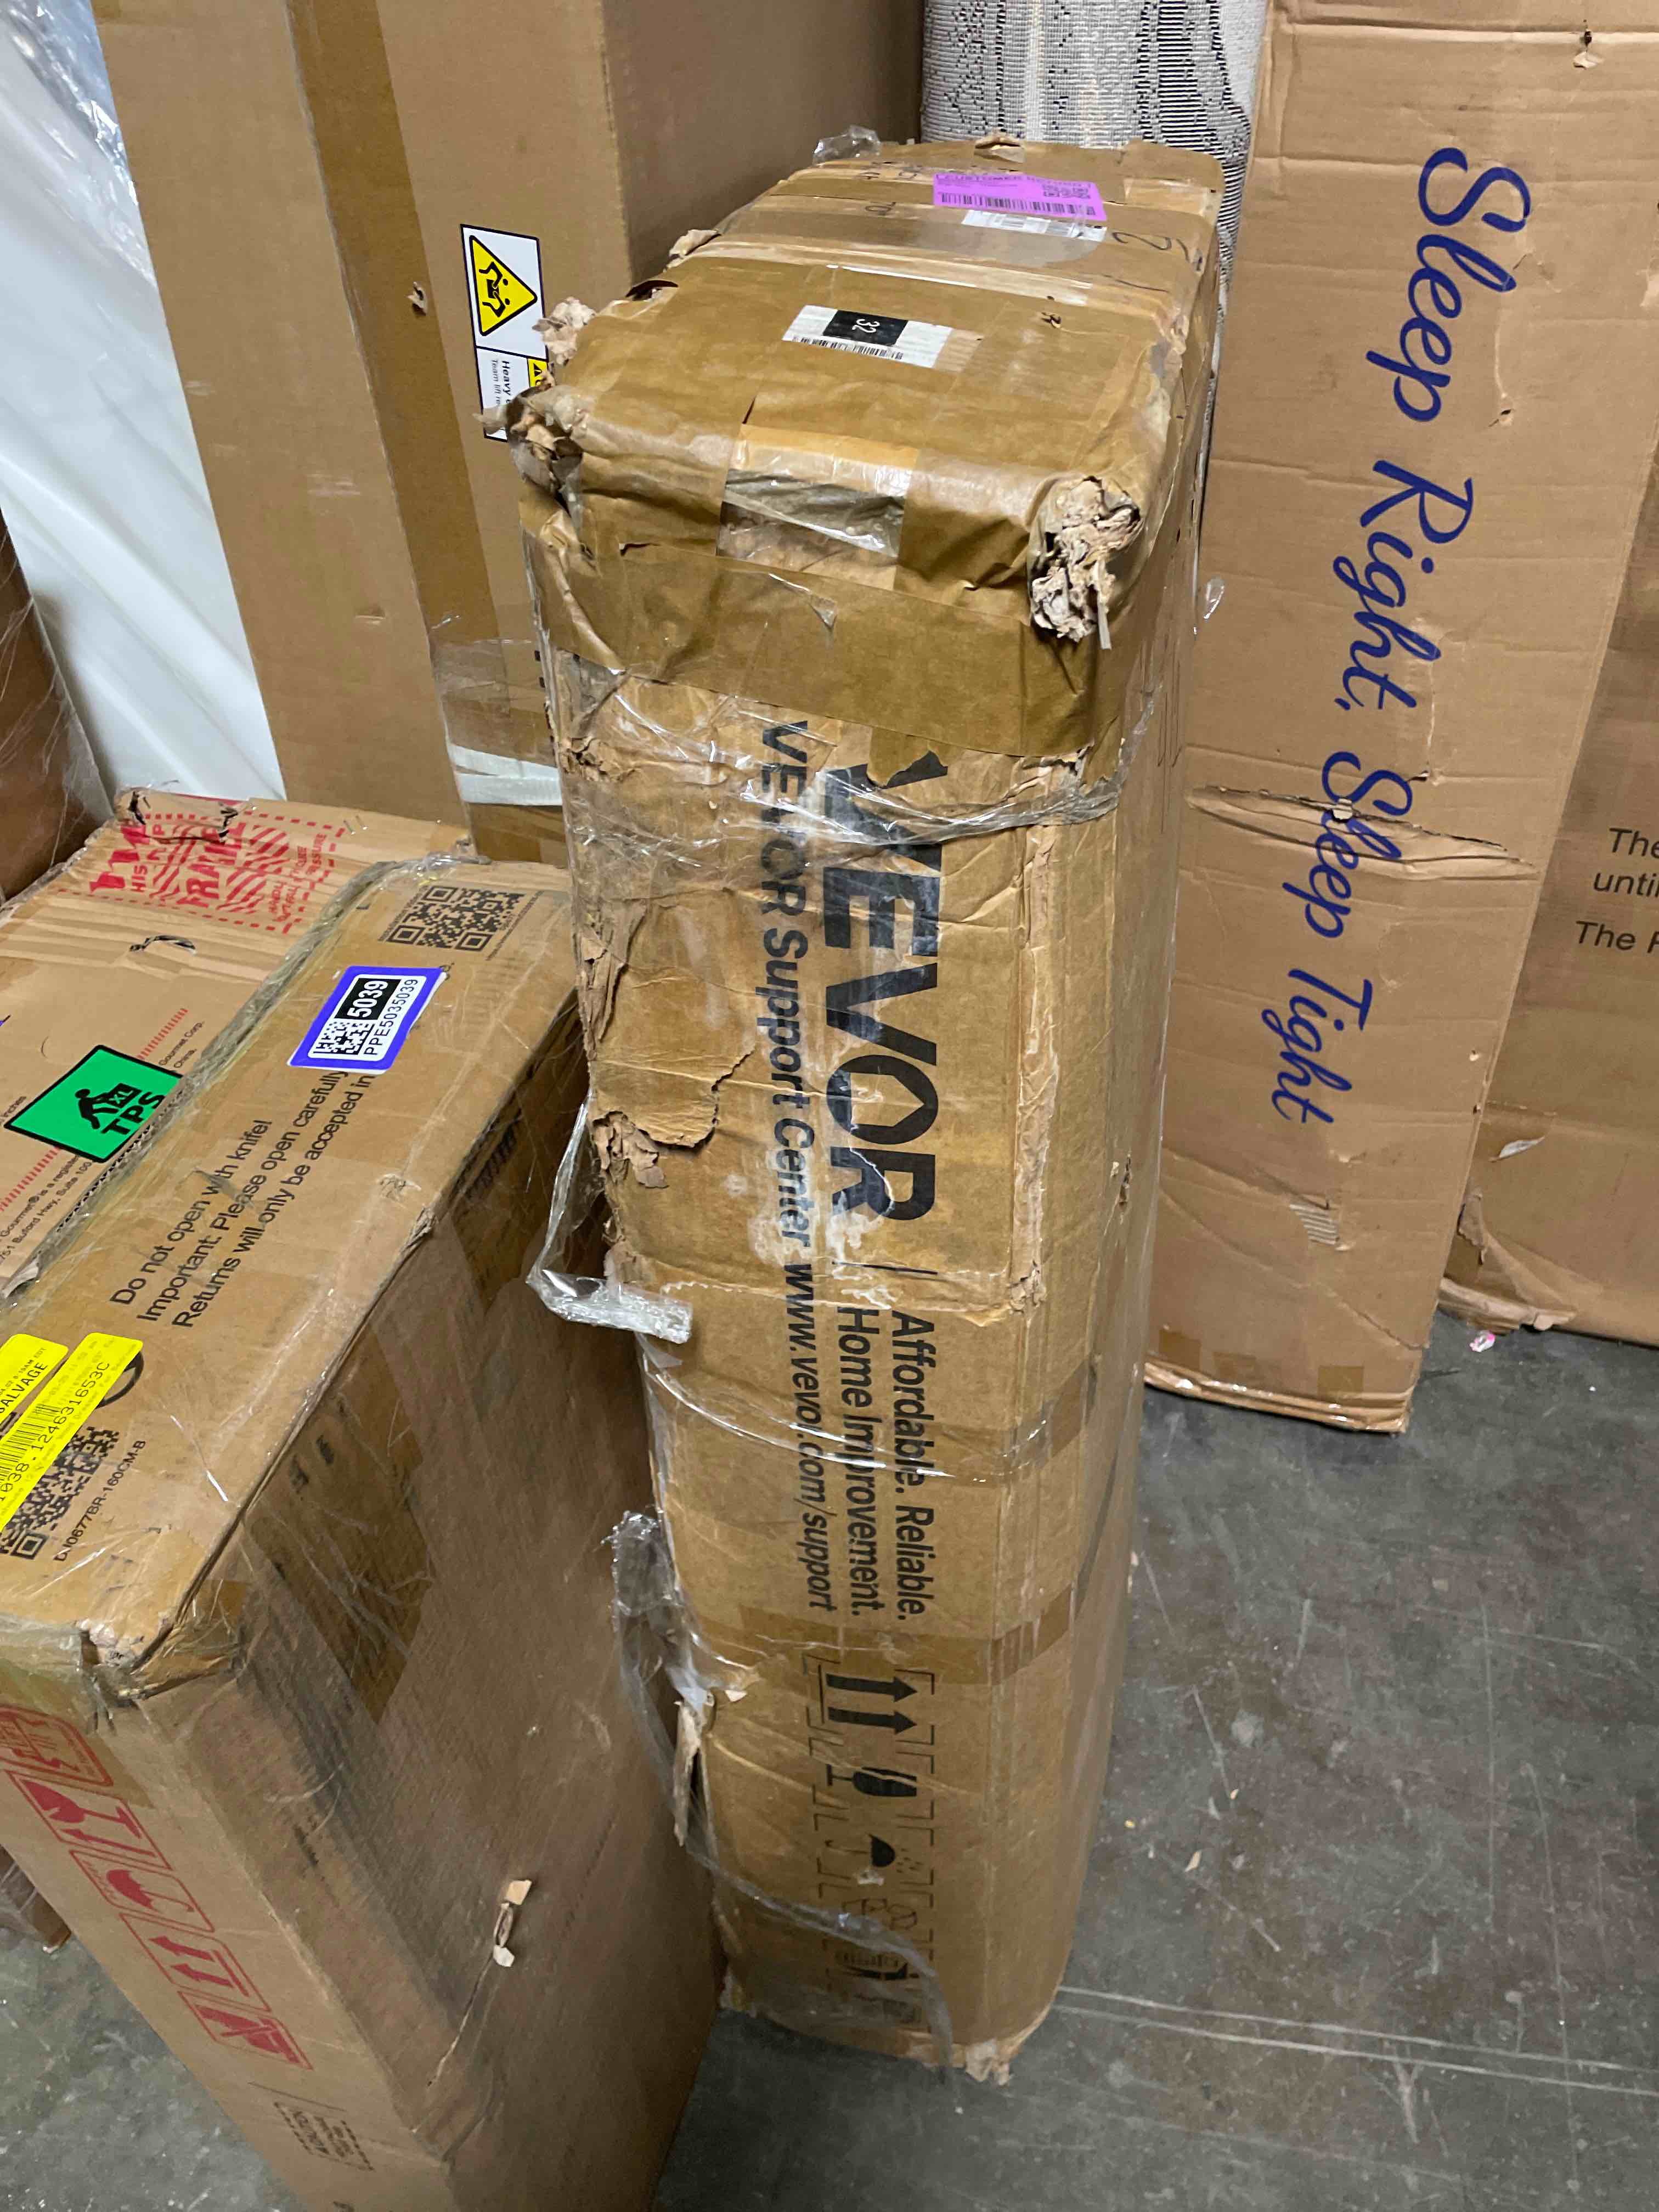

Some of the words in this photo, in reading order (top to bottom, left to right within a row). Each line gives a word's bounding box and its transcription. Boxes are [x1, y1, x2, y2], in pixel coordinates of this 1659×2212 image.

[851, 319, 880, 333] 32
[1366, 147, 1531, 422] Sleep
[501, 360, 511, 396] Heavy
[1283, 751, 1413, 938] Sleep
[822, 750, 948, 1221] VEVOR
[1575, 920, 1636, 951] The
[346, 980, 388, 1018] 5039
[363, 979, 419, 1056] PPE5035039
[755, 927, 810, 1109] Support
[1261, 968, 1373, 1124] Tight
[101, 1091, 167, 1135] TPS
[109, 1090, 134, 1104] XL
[137, 1235, 222, 1322] Important:
[211, 1174, 267, 1231] Please
[261, 1131, 300, 1171] open
[171, 1257, 241, 1328] Returns
[233, 1226, 266, 1255] will
[258, 1188, 296, 1223] only
[284, 1164, 311, 1187] be
[304, 1091, 364, 1161] accepted
[350, 1074, 376, 1090] in
[774, 1118, 815, 1248] Center
[109, 1278, 146, 1306] Do
[141, 1245, 175, 1274] not
[167, 1199, 211, 1243] open
[837, 1306, 880, 1408] Home
[890, 1310, 936, 1494] Affordable.
[843, 1413, 885, 1616] Improvement.
[895, 1505, 936, 1621] Reliable.
